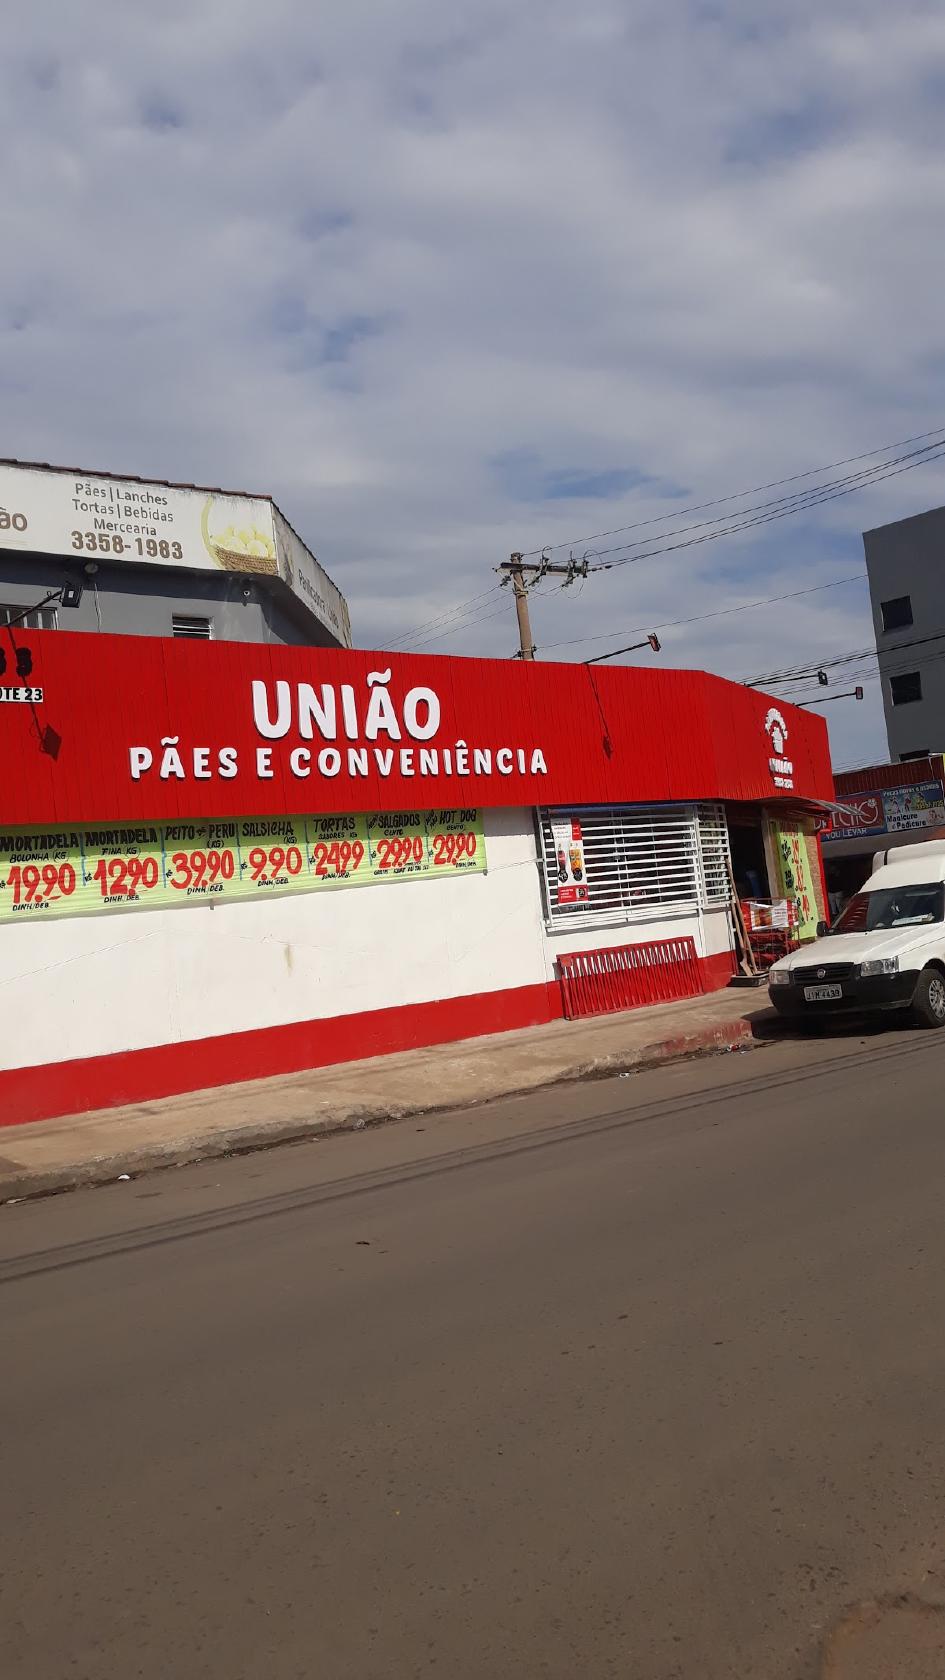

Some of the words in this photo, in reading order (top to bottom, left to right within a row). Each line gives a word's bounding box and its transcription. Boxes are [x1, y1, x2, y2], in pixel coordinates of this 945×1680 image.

[75, 483, 106, 498] Pães
[117, 488, 168, 506] Lanches
[72, 498, 114, 515] Tortas
[124, 505, 173, 522] Bebidas
[94, 518, 157, 536] Mercearia
[71, 531, 183, 560] 3358-1983
[25, 687, 43, 701] 23
[251, 667, 440, 741] UNIÃO
[129, 735, 238, 779] PÃES
[256, 747, 274, 778] E
[289, 739, 548, 777] CONVENIÊNCIA
[313, 816, 356, 833] TORTAS
[378, 813, 421, 829] SALGADOS
[439, 810, 457, 825] HOT
[460, 808, 477, 823] DOG
[886, 813, 918, 823] Manicure
[896, 820, 927, 830] Pedicure
[85, 828, 158, 847] MORTADELA
[164, 825, 195, 841] PEITO
[208, 823, 235, 840] PERU
[242, 821, 295, 837] SALSICHA
[843, 828, 868, 837] LEVAR
[0, 833, 79, 852] MORTADELA
[9, 852, 49, 863] BOLONHA
